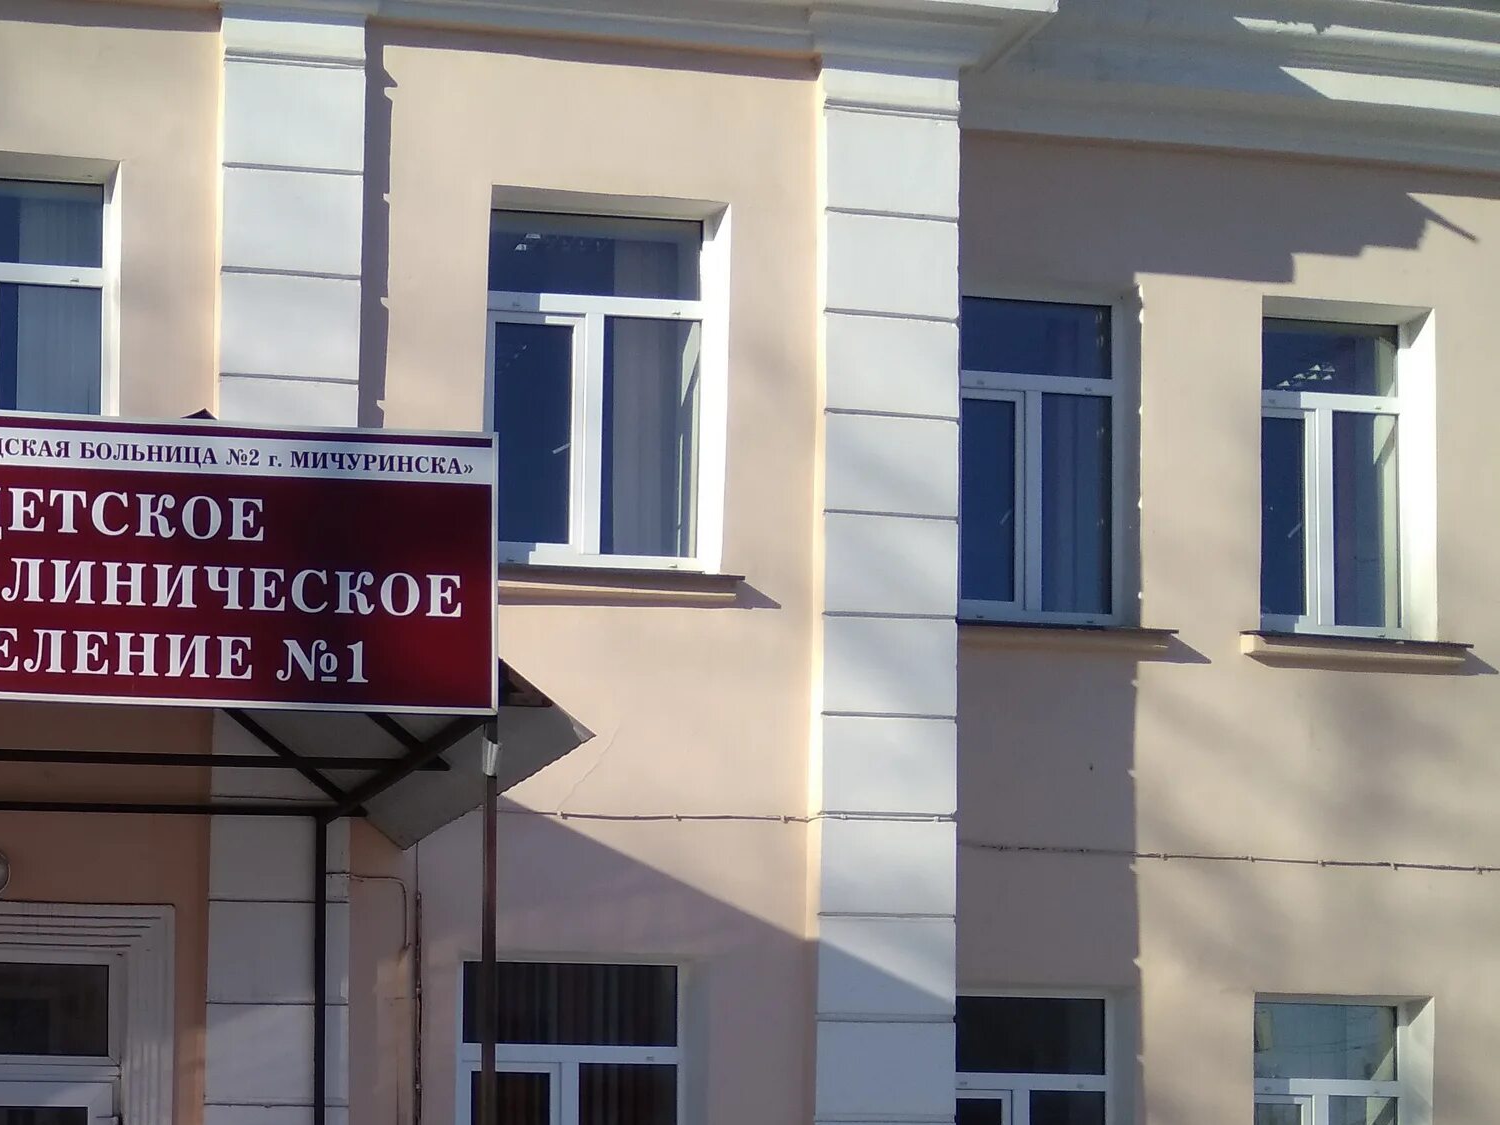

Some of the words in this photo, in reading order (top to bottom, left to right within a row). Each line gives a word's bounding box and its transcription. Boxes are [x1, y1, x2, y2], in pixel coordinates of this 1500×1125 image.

[79, 441, 218, 468] БОЛЬНИЦА
[226, 448, 260, 467] №2
[268, 454, 282, 468] г.
[290, 450, 474, 475] МИЧУРИНСКА»
[275, 639, 369, 683] №1
